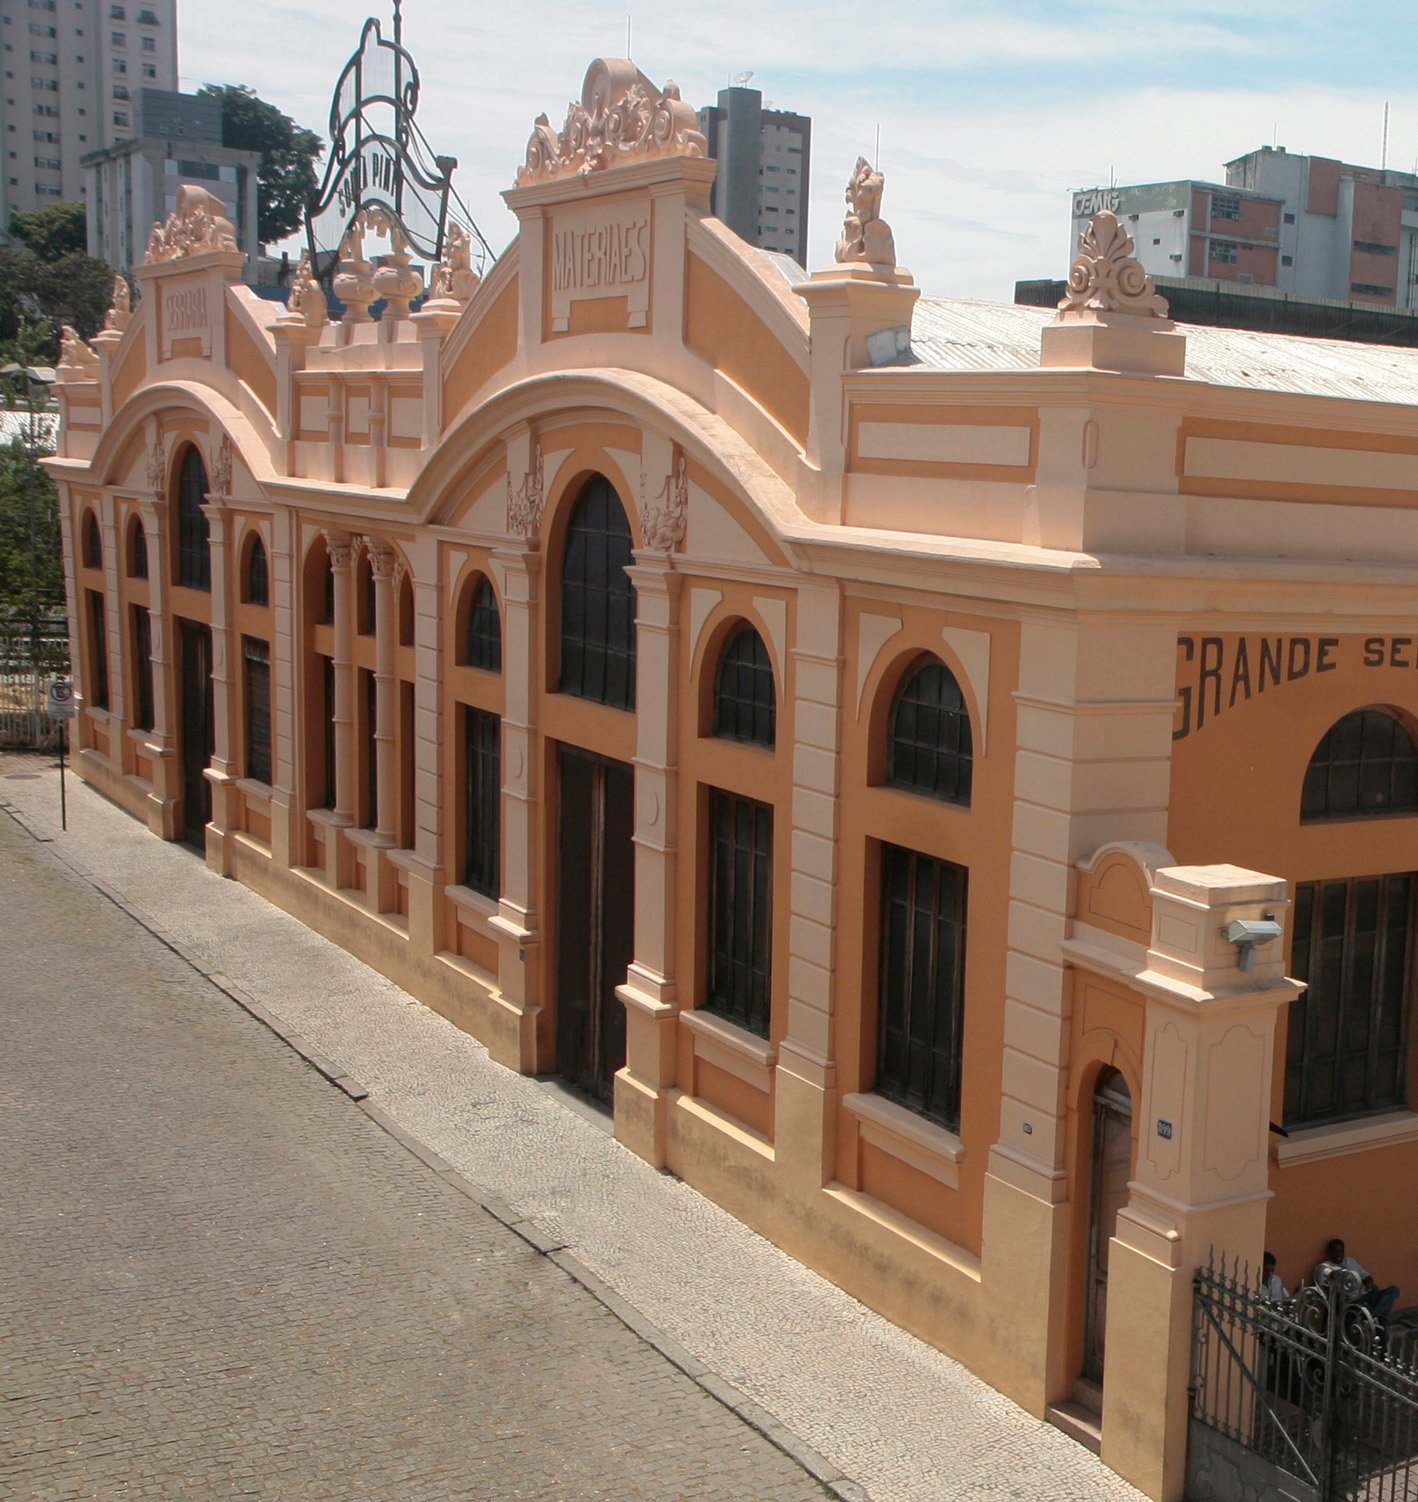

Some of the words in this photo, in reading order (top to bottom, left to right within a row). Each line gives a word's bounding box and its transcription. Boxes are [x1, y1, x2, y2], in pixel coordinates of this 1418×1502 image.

[1074, 192, 1120, 215] CEMIG
[554, 219, 648, 290] MATERIAES
[1172, 636, 1339, 741] GRANDE
